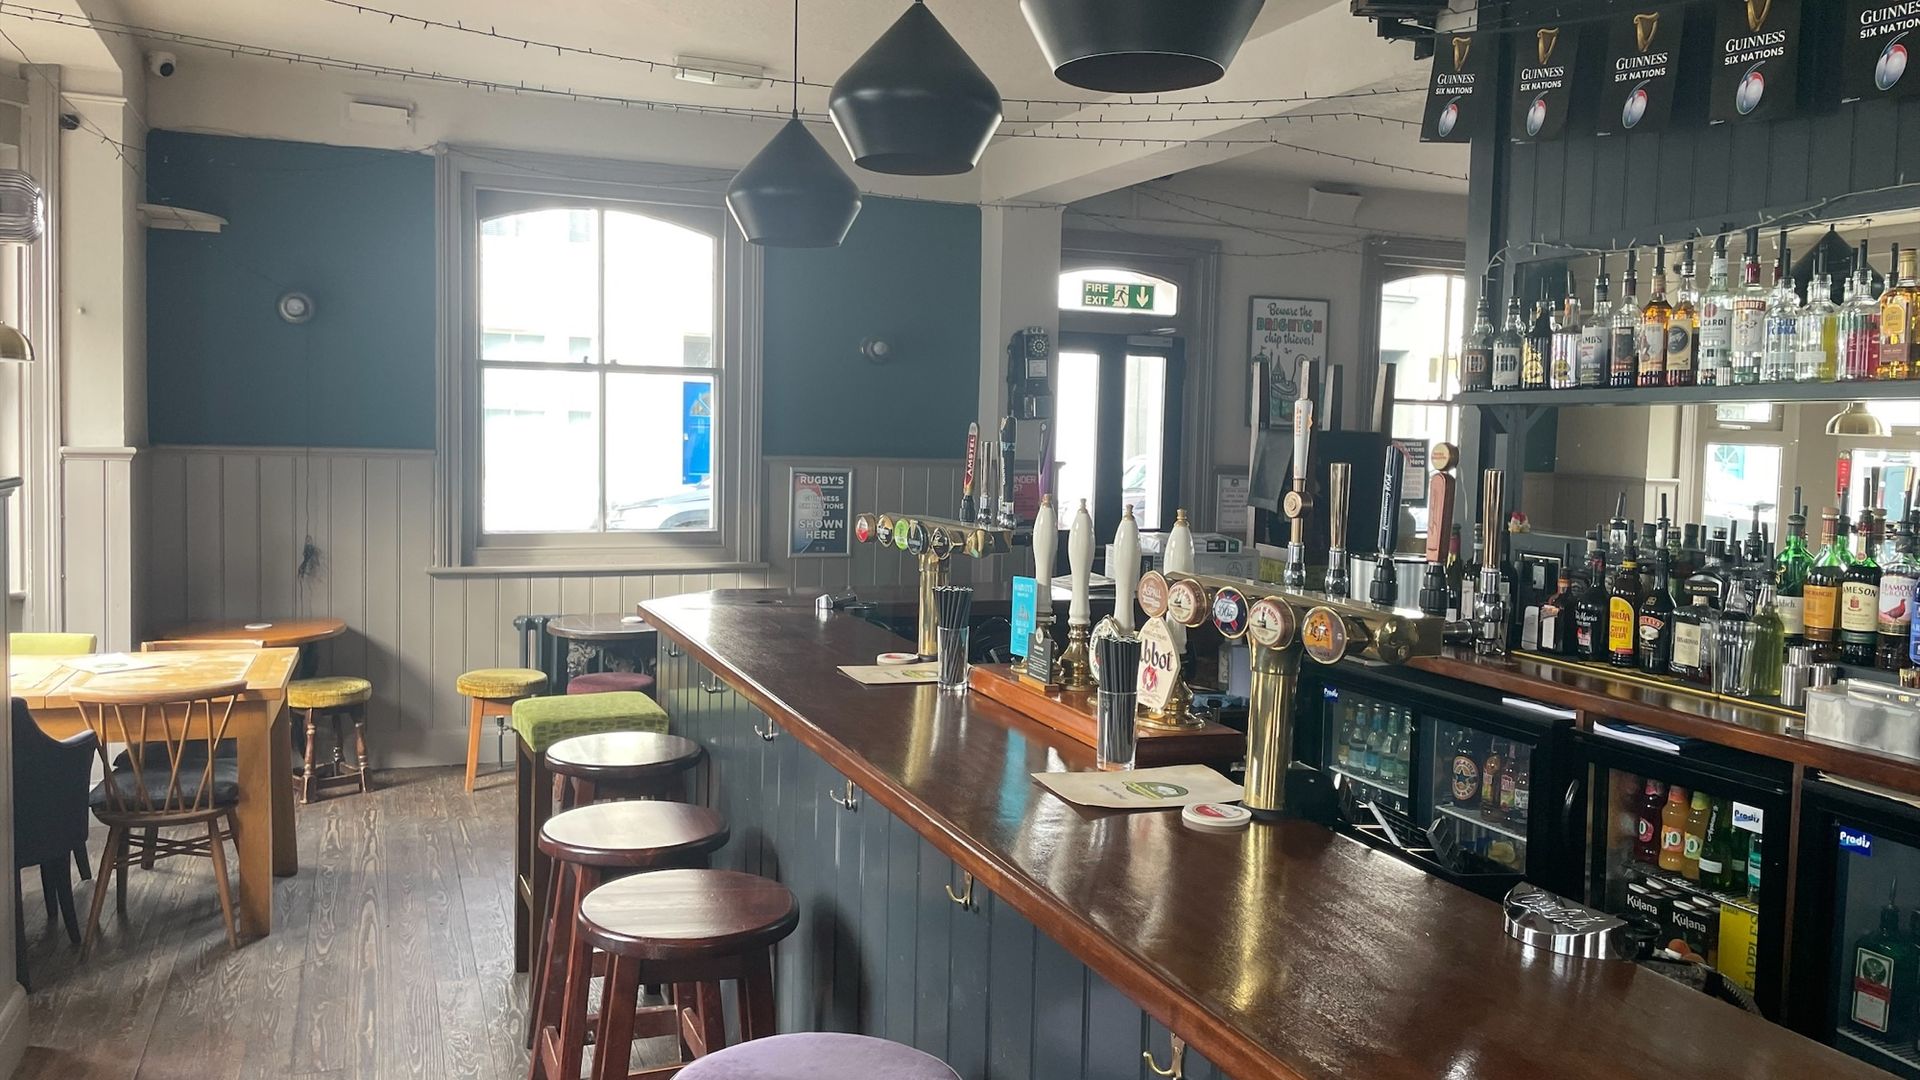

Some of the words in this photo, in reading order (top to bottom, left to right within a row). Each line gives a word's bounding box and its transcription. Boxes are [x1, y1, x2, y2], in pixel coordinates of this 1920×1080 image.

[1860, 27, 1877, 39] SIX
[1725, 29, 1786, 53] GUINNESS
[1615, 52, 1669, 71] GUINNESS
[1724, 55, 1739, 66] SIX
[1741, 46, 1785, 62] NATIONS
[1437, 73, 1475, 84] GUINNESS
[1521, 66, 1564, 80] GUINNESS
[1615, 72, 1627, 82] SIX
[1629, 67, 1666, 80] NATIONS
[1435, 87, 1443, 95] SIX
[1447, 86, 1473, 95] NATIONS
[1520, 82, 1530, 92] SIX
[1531, 80, 1562, 90] NATIONS
[1085, 283, 1109, 293] FIRE
[1085, 295, 1108, 305] EXIT
[1267, 302, 1298, 316] Beware
[1300, 305, 1312, 317] the
[1256, 317, 1323, 333] BRIGHTON
[1264, 331, 1281, 349] chip
[1283, 334, 1315, 346] thieves!
[800, 475, 845, 485] RUGBY'S
[1014, 475, 1037, 484] NDER
[800, 519, 843, 529] SHOWN
[805, 530, 836, 540] HERE
[1842, 586, 1877, 598] AMESON
[1140, 638, 1174, 672] bbot
[1735, 810, 1760, 824] Prodis
[1839, 831, 1871, 849] Prodis
